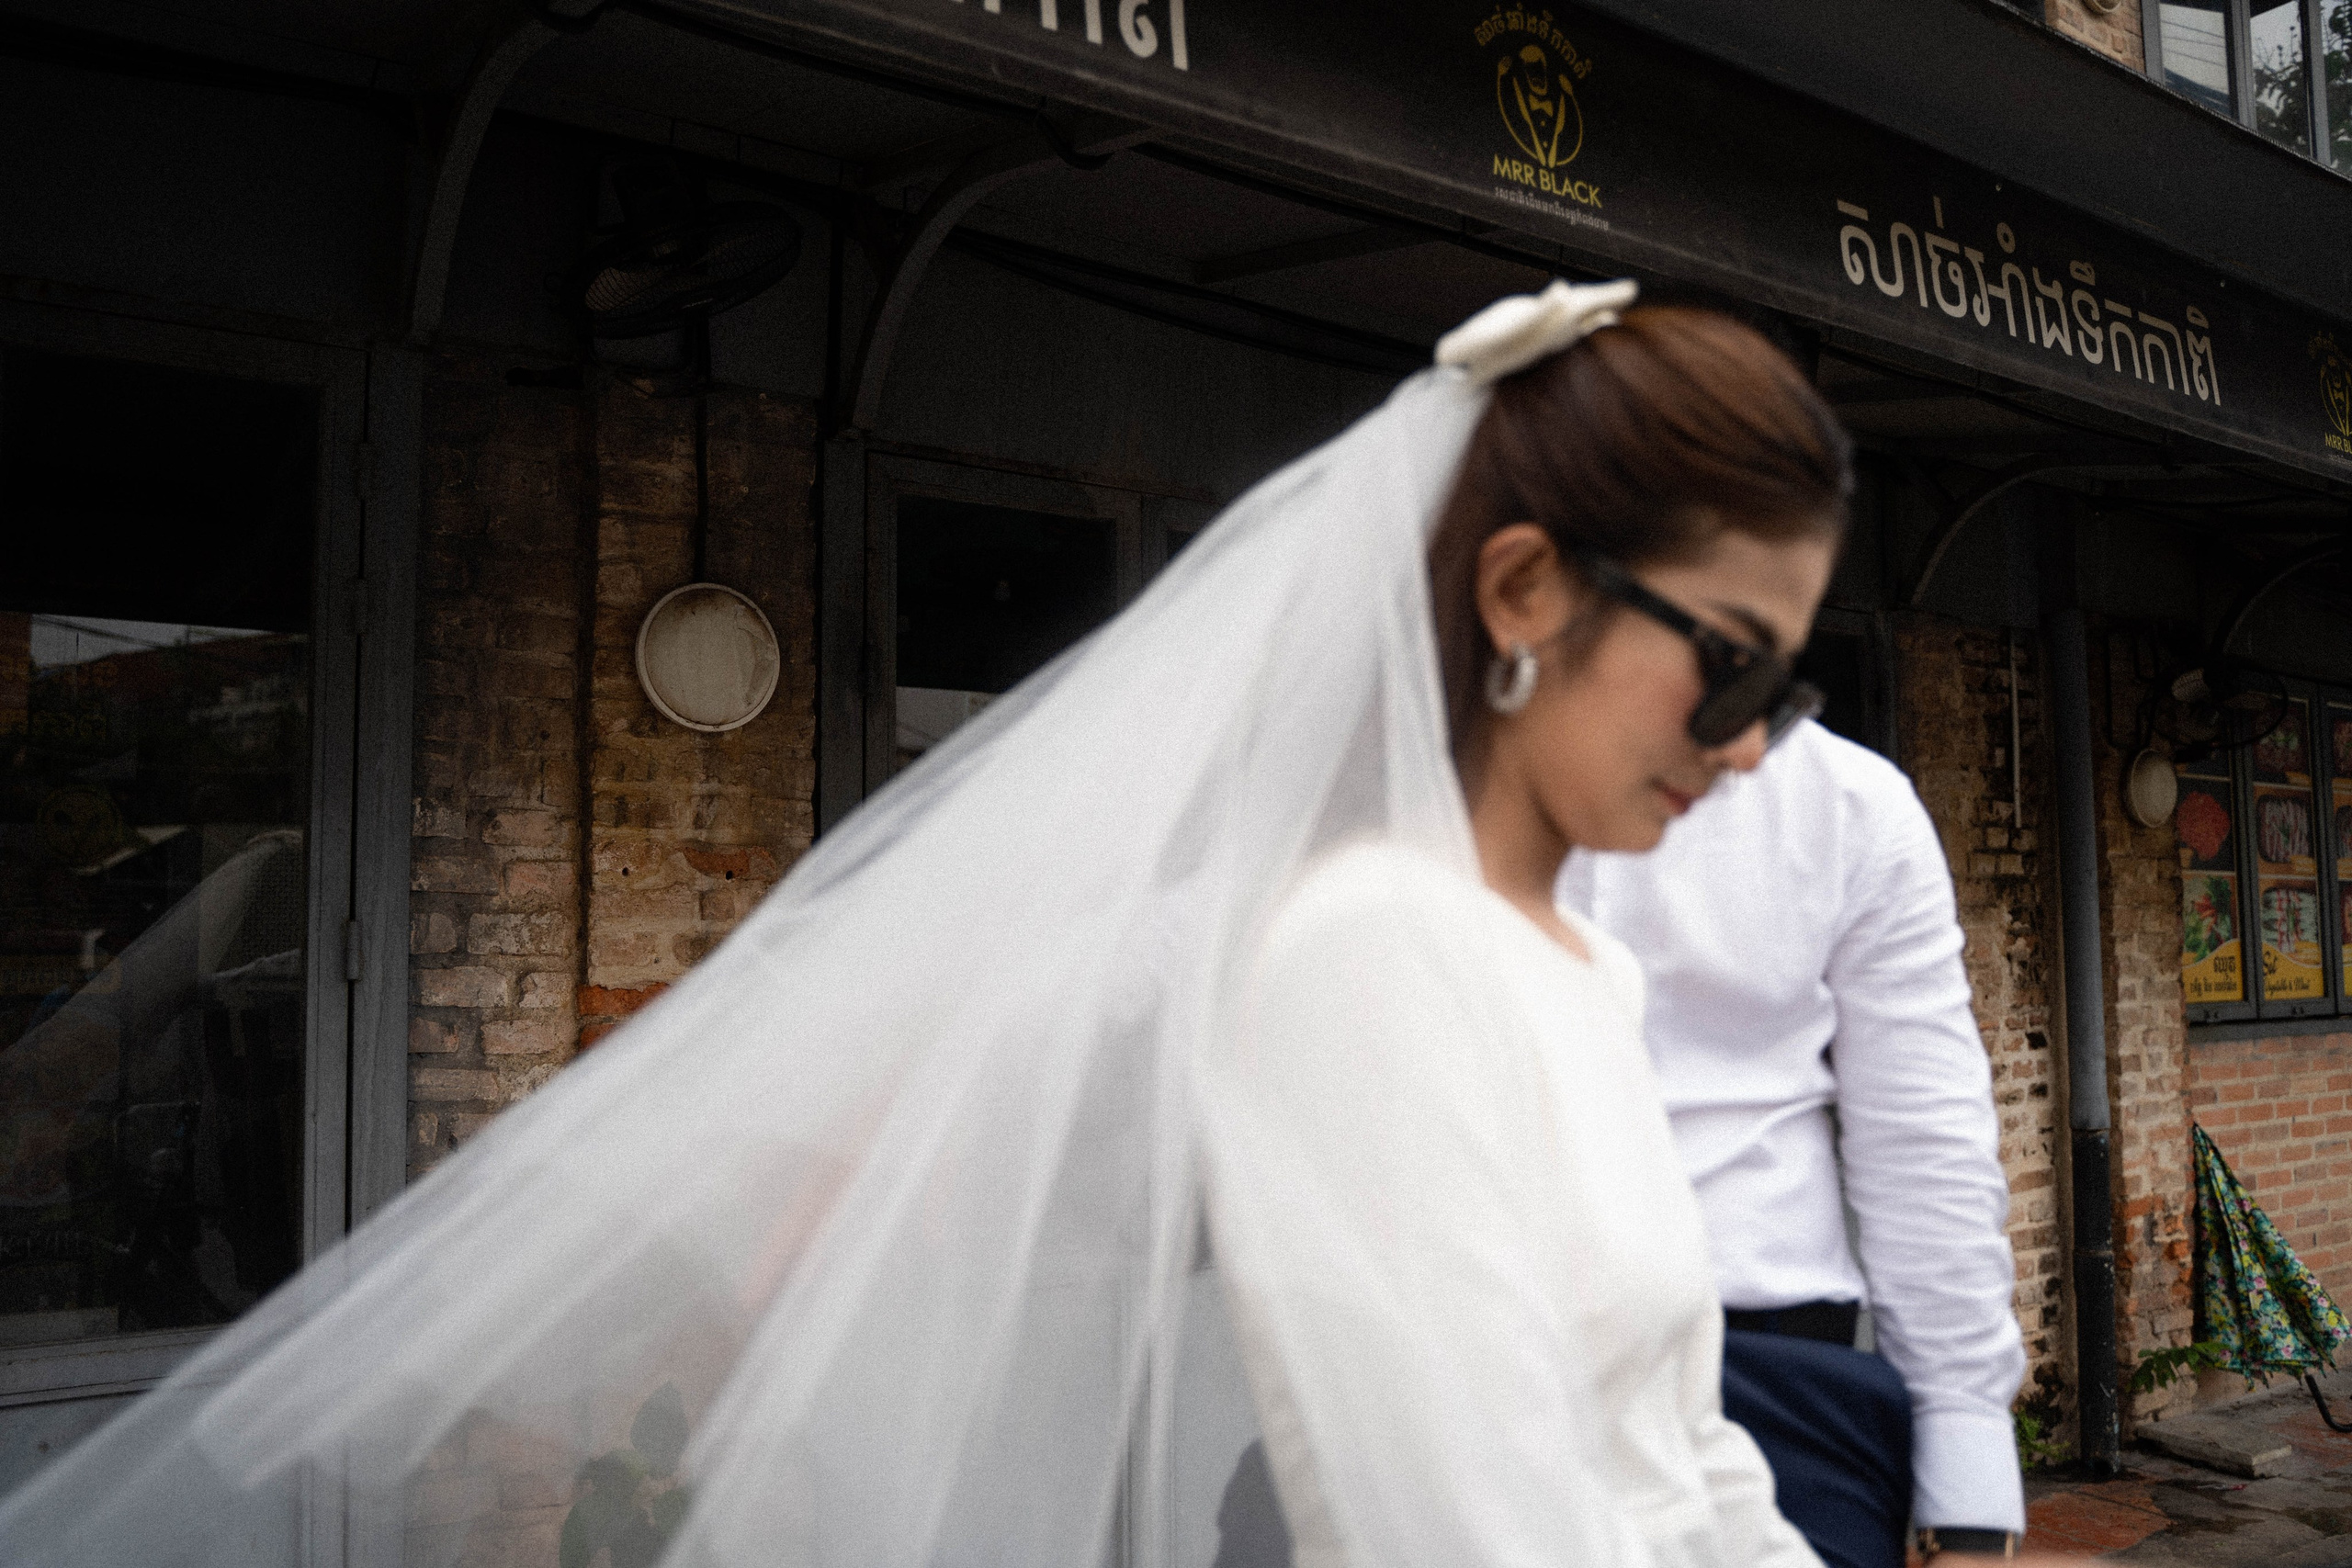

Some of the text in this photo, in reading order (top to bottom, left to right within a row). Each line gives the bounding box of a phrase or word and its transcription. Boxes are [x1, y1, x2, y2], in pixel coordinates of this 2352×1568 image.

[1493, 153, 1603, 209] MRR BLACK
[2324, 432, 2344, 452] MRR
